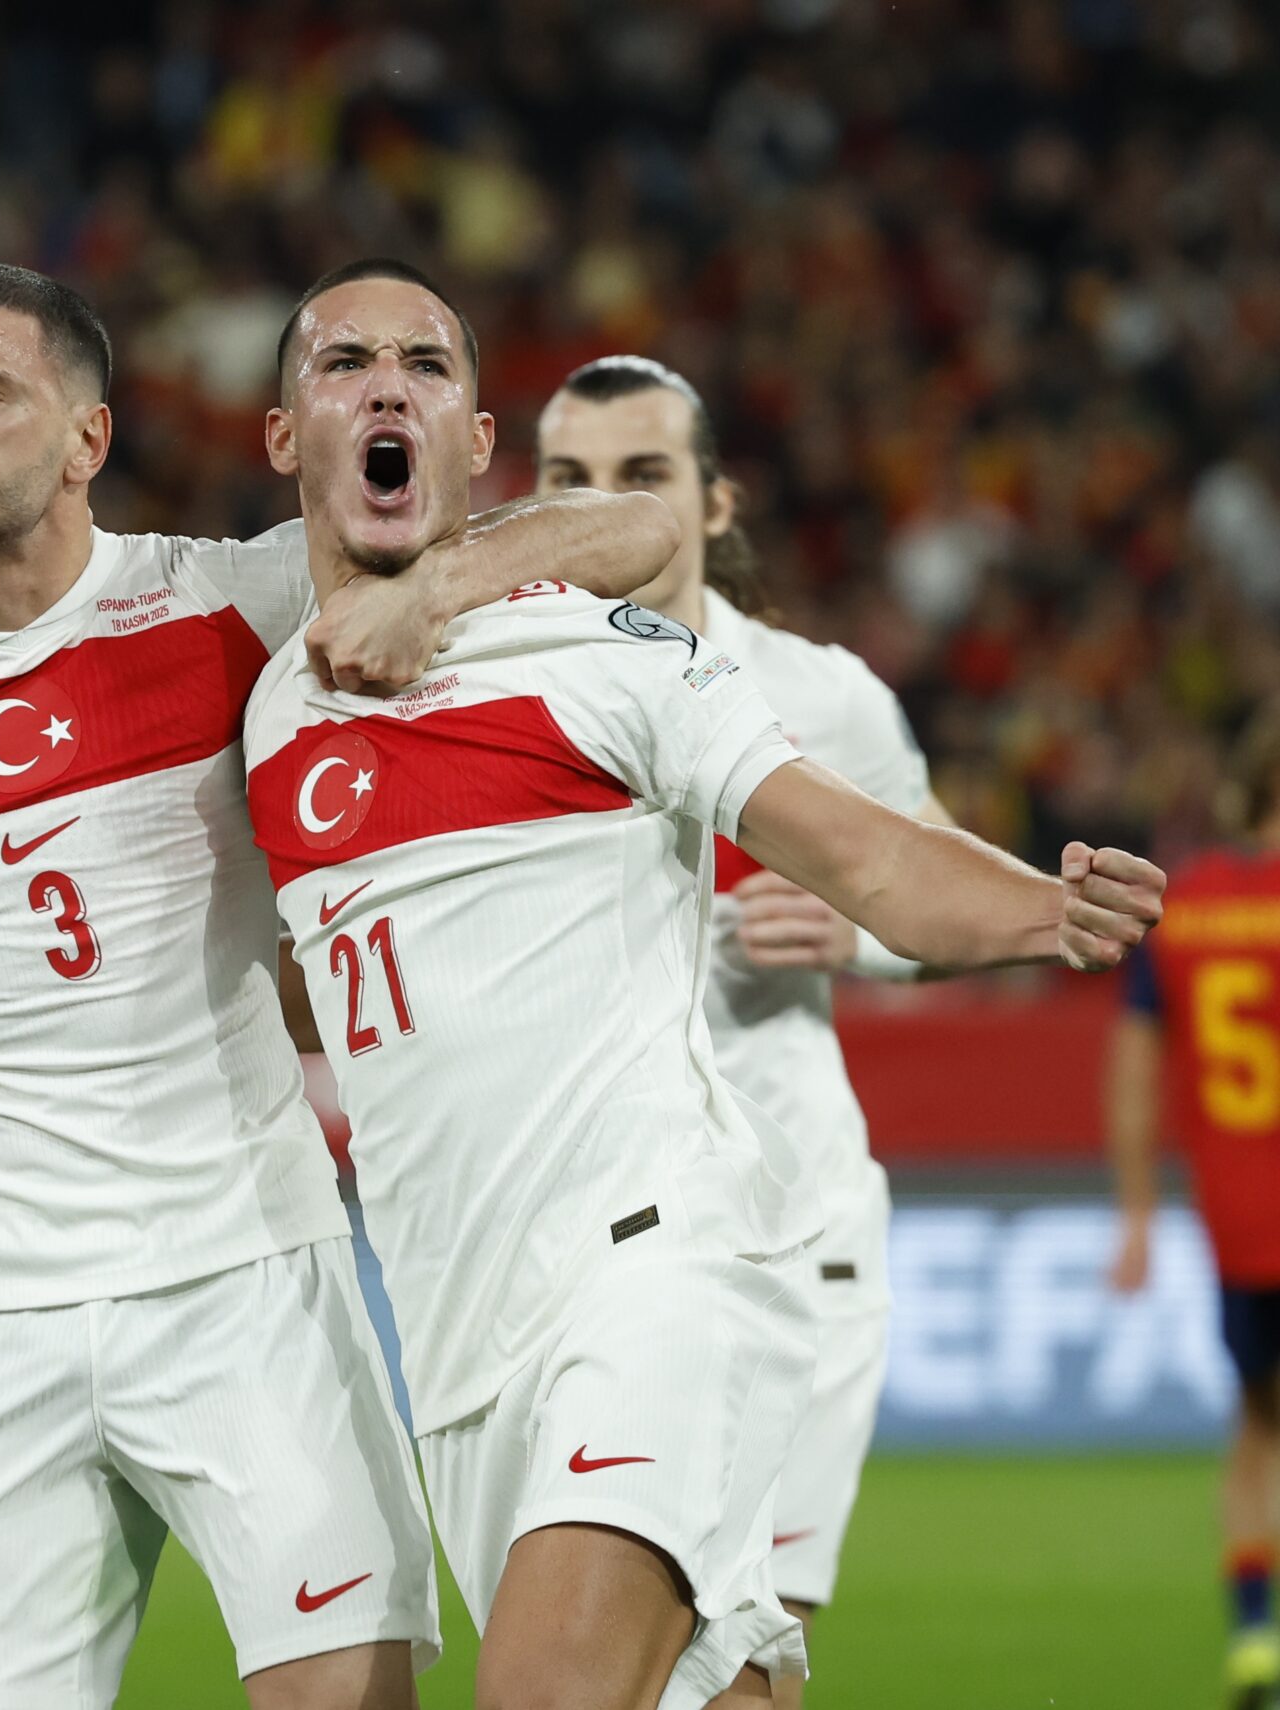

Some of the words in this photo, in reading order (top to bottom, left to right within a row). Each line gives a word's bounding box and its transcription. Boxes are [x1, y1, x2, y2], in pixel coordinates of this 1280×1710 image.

[111, 618, 122, 633] 18
[122, 612, 151, 632] KASIM
[150, 604, 170, 622] 2025
[28, 870, 102, 981] 3
[329, 916, 416, 1059] 21
[1193, 958, 1280, 1134] 5
